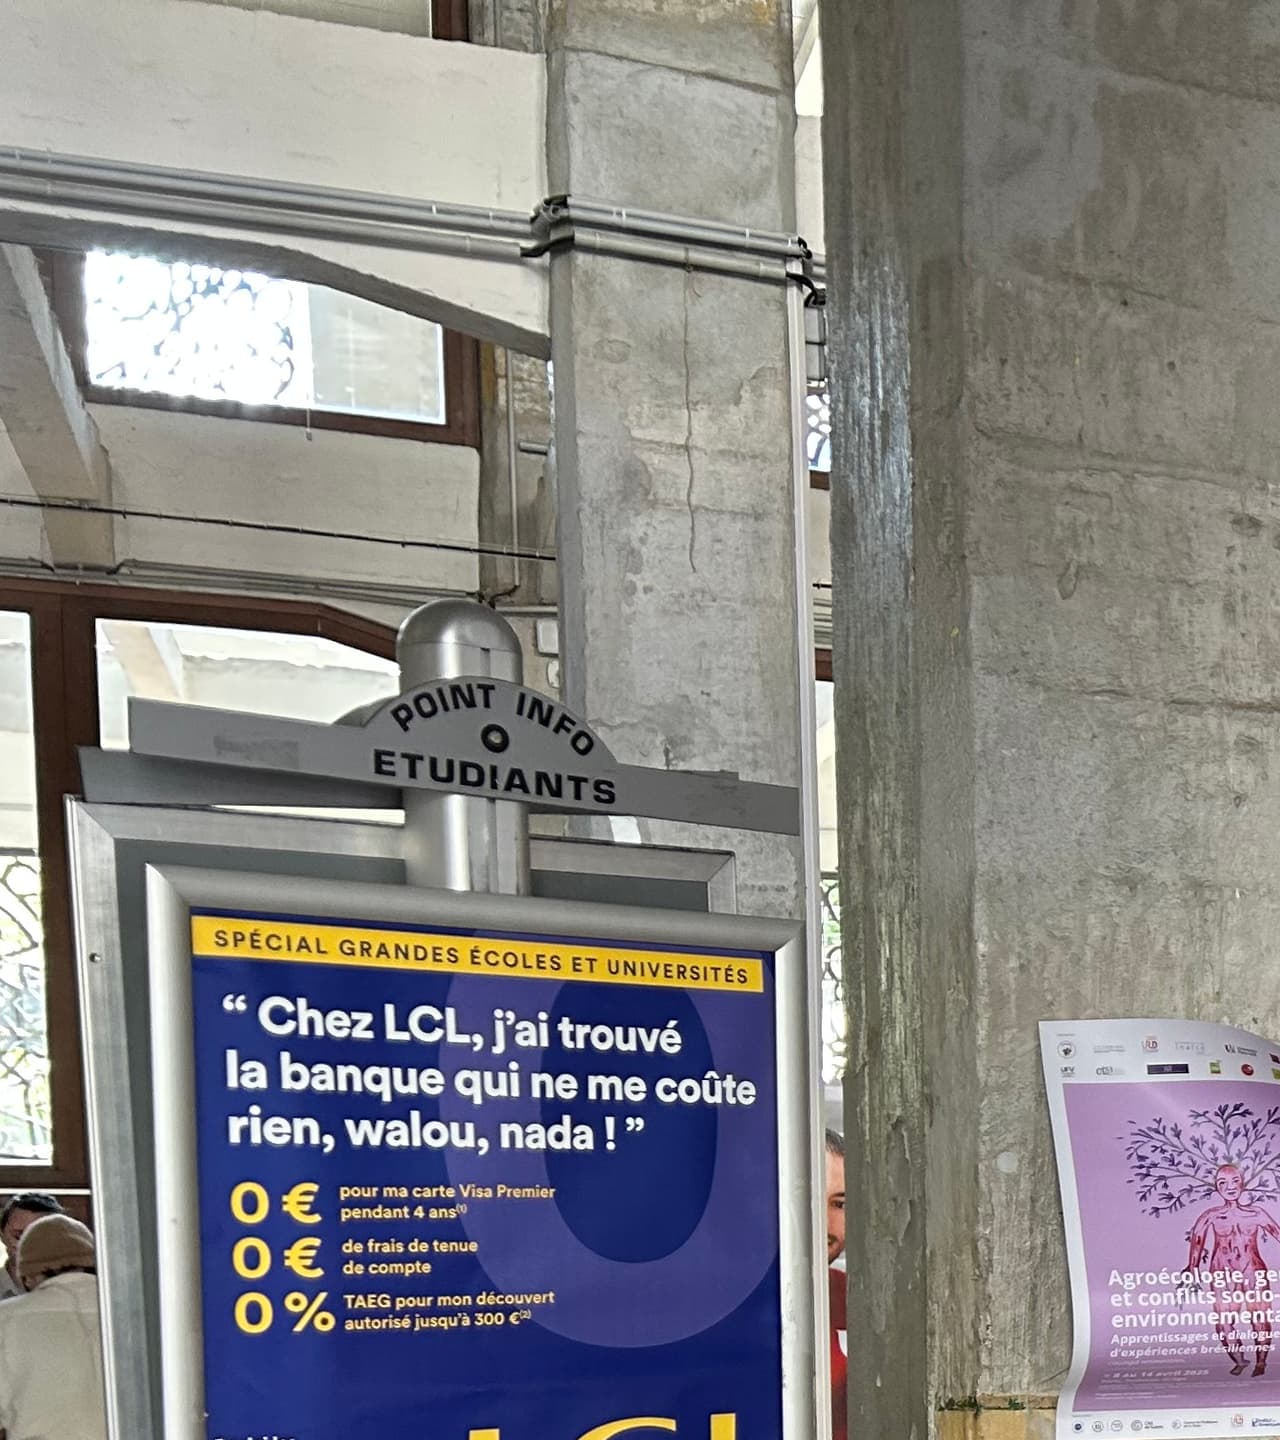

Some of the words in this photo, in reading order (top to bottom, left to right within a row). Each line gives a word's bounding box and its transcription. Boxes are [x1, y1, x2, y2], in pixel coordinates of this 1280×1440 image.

[391, 683, 496, 734] POINT
[515, 691, 595, 757] INFO
[373, 748, 617, 805] ETUDIANTS
[214, 929, 329, 955] SPÉCIAL
[338, 939, 460, 964] GRANDES
[469, 945, 563, 971] ÉCOLES
[572, 957, 599, 974] ET
[607, 959, 749, 985] UNIVERSITÉS
[257, 995, 376, 1039] Chez
[383, 1003, 484, 1051] LCL,
[491, 1008, 549, 1055] j'ai
[557, 1016, 683, 1054] trouvé
[226, 1048, 269, 1089] la
[279, 1050, 446, 1102] banque
[453, 1060, 520, 1105] qui
[530, 1072, 579, 1100] ne
[587, 1074, 648, 1102] me
[655, 1070, 757, 1105] coûte
[228, 1105, 336, 1153] rien,
[344, 1109, 490, 1156] walou,
[499, 1114, 595, 1151] nada
[230, 1181, 270, 1224] 0
[281, 1182, 323, 1224] €
[340, 1184, 378, 1201] pour
[383, 1186, 408, 1199] ma
[412, 1185, 456, 1199] carte
[459, 1183, 492, 1199] Visa
[496, 1183, 557, 1200] Premier
[340, 1205, 411, 1222] pendant
[413, 1205, 425, 1219] 4
[232, 1237, 272, 1280] 0
[283, 1237, 325, 1279] €
[342, 1239, 365, 1254] de
[367, 1238, 405, 1254] frais
[409, 1239, 429, 1253] de
[432, 1239, 479, 1254] tenue
[342, 1260, 366, 1275] de
[368, 1260, 432, 1277] compte
[1108, 1268, 1249, 1290] Agroécologie,
[234, 1291, 274, 1334] 0
[284, 1291, 337, 1333] %
[343, 1294, 392, 1310] TAEG
[395, 1295, 434, 1311] pour
[438, 1296, 476, 1308] mon
[476, 1290, 556, 1307] découvert
[1110, 1291, 1133, 1307] et
[1137, 1287, 1217, 1307] conflits
[1221, 1286, 1280, 1304] socio-
[344, 1315, 412, 1331] autorisé
[413, 1312, 471, 1334] jusqu'à
[474, 1313, 506, 1327] 300
[1110, 1331, 1209, 1347] Apprentissages
[1211, 1331, 1226, 1341] et
